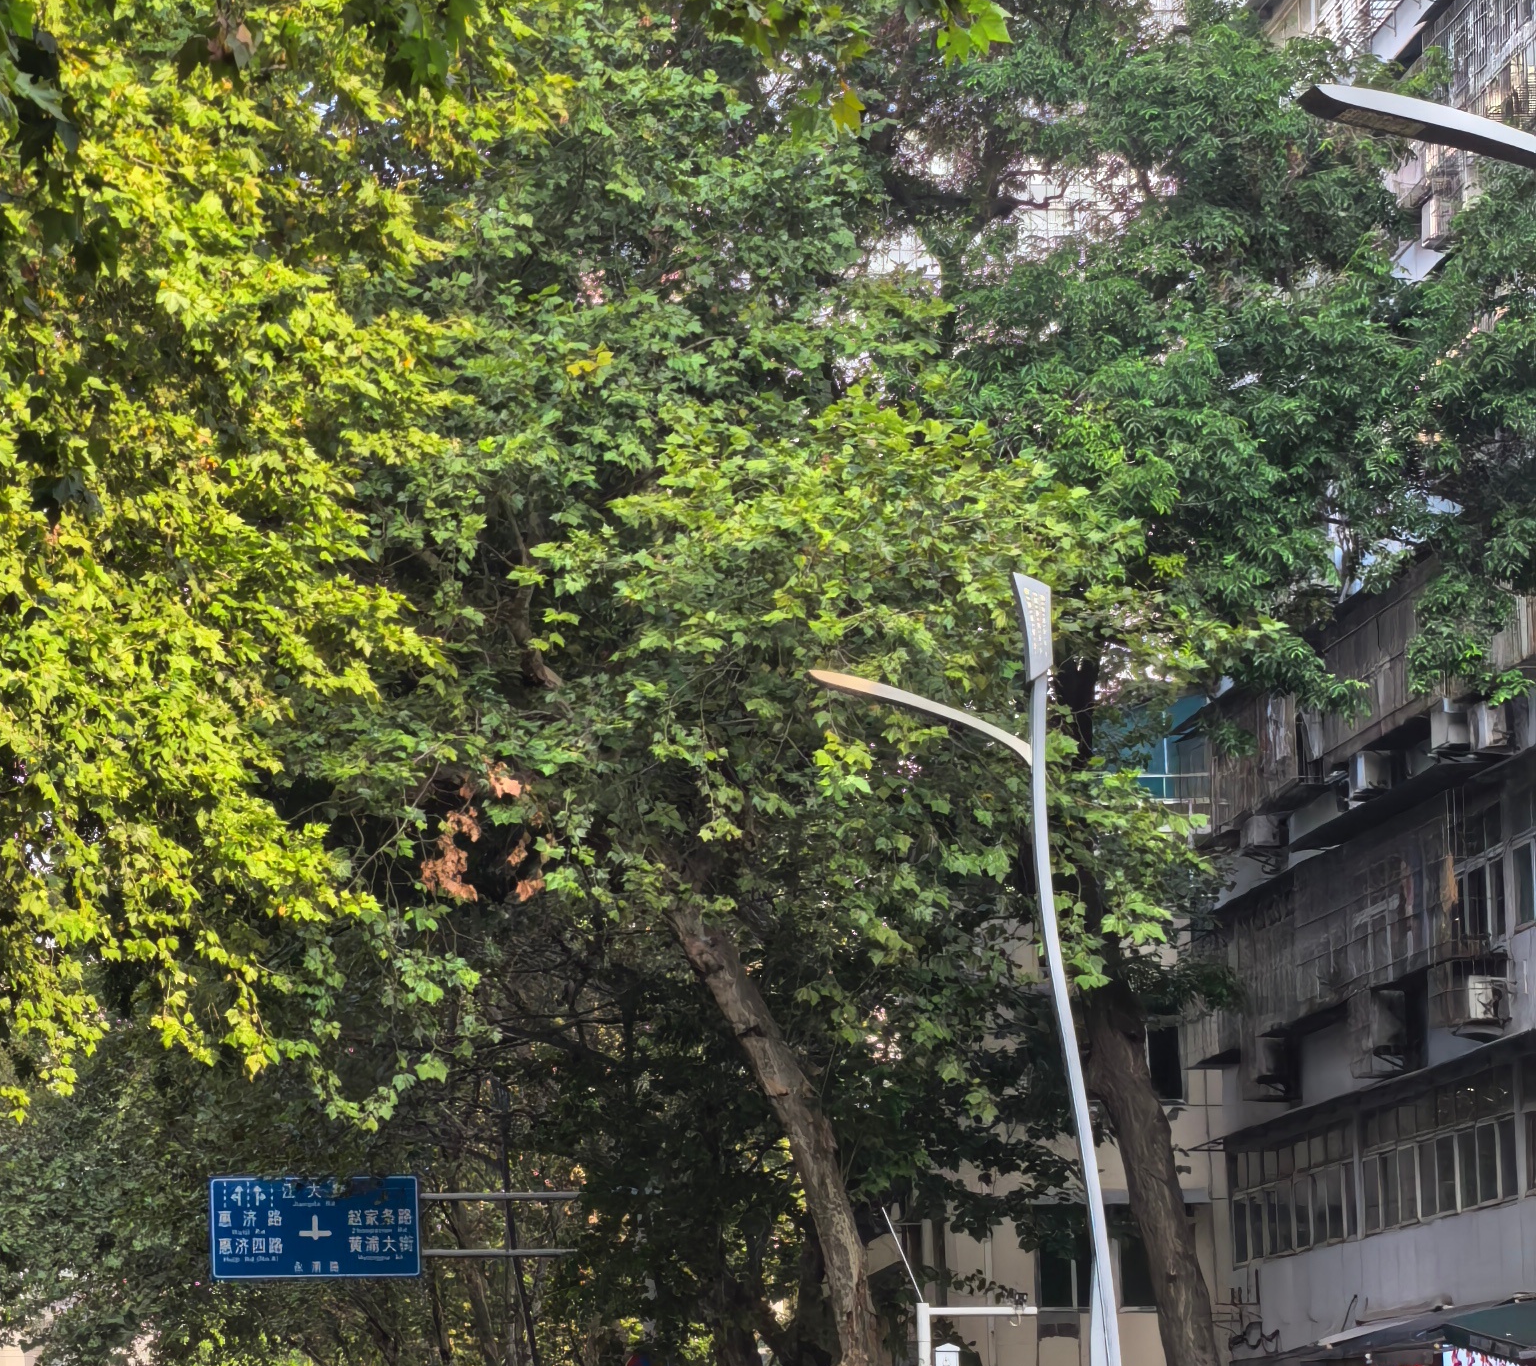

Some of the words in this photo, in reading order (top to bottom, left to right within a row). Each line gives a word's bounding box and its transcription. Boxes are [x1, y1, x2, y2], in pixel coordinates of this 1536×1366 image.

[218, 1237, 284, 1255] 惠济四路
[348, 1235, 415, 1253] 黄浦大街
